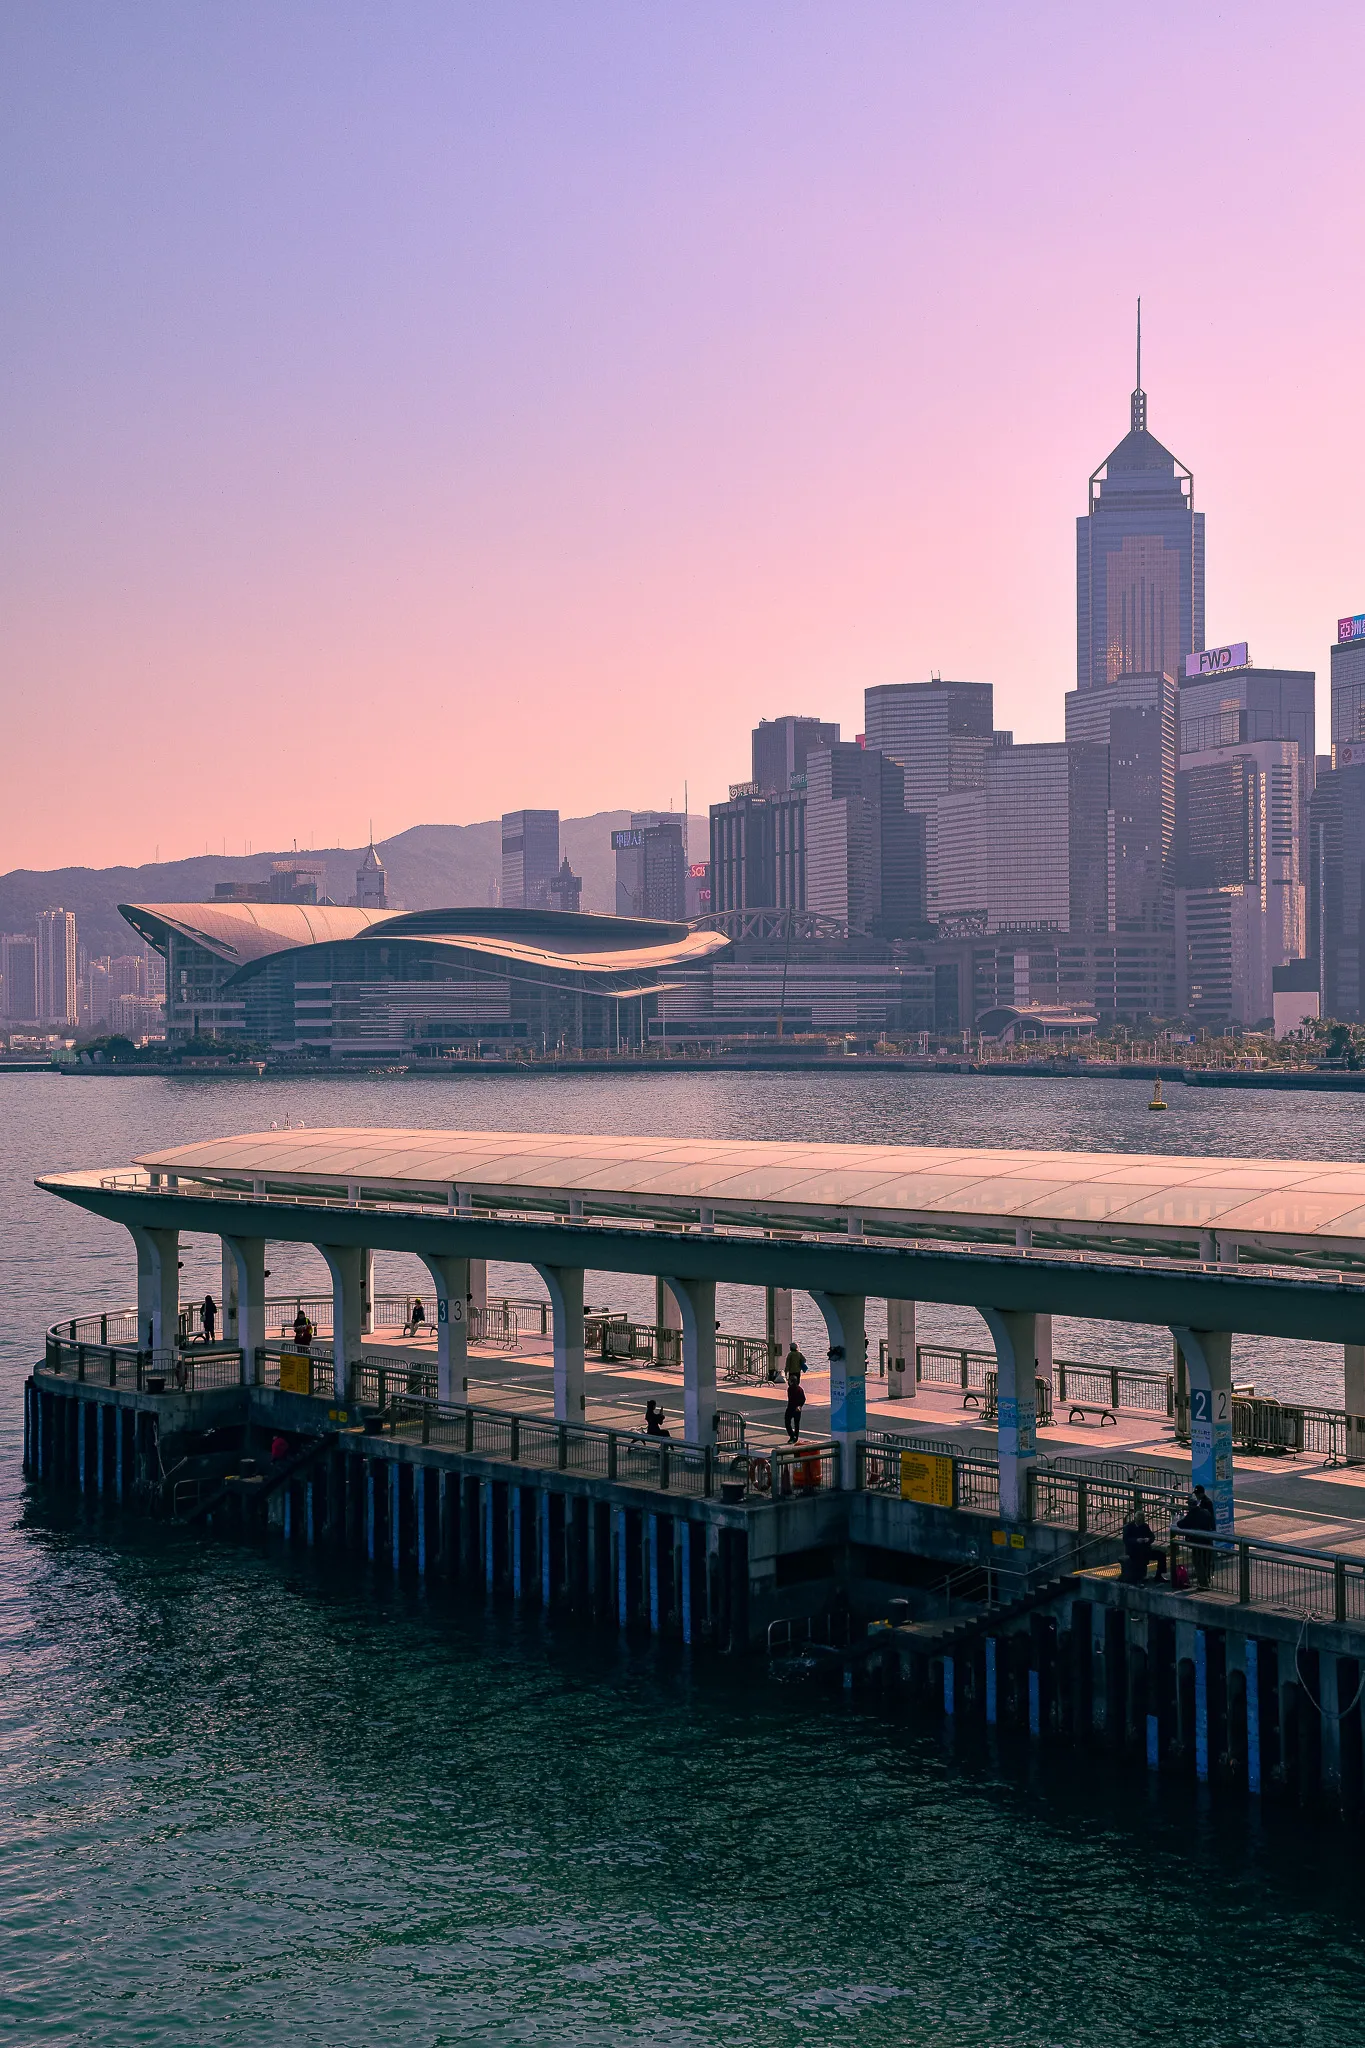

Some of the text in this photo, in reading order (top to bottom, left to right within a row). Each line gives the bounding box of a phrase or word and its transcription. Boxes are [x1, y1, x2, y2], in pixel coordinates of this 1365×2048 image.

[1199, 648, 1232, 671] FWD
[440, 1300, 446, 1321] 3
[454, 1300, 462, 1320] 3
[1195, 1391, 1207, 1420] 2
[1218, 1391, 1227, 1419] 2
